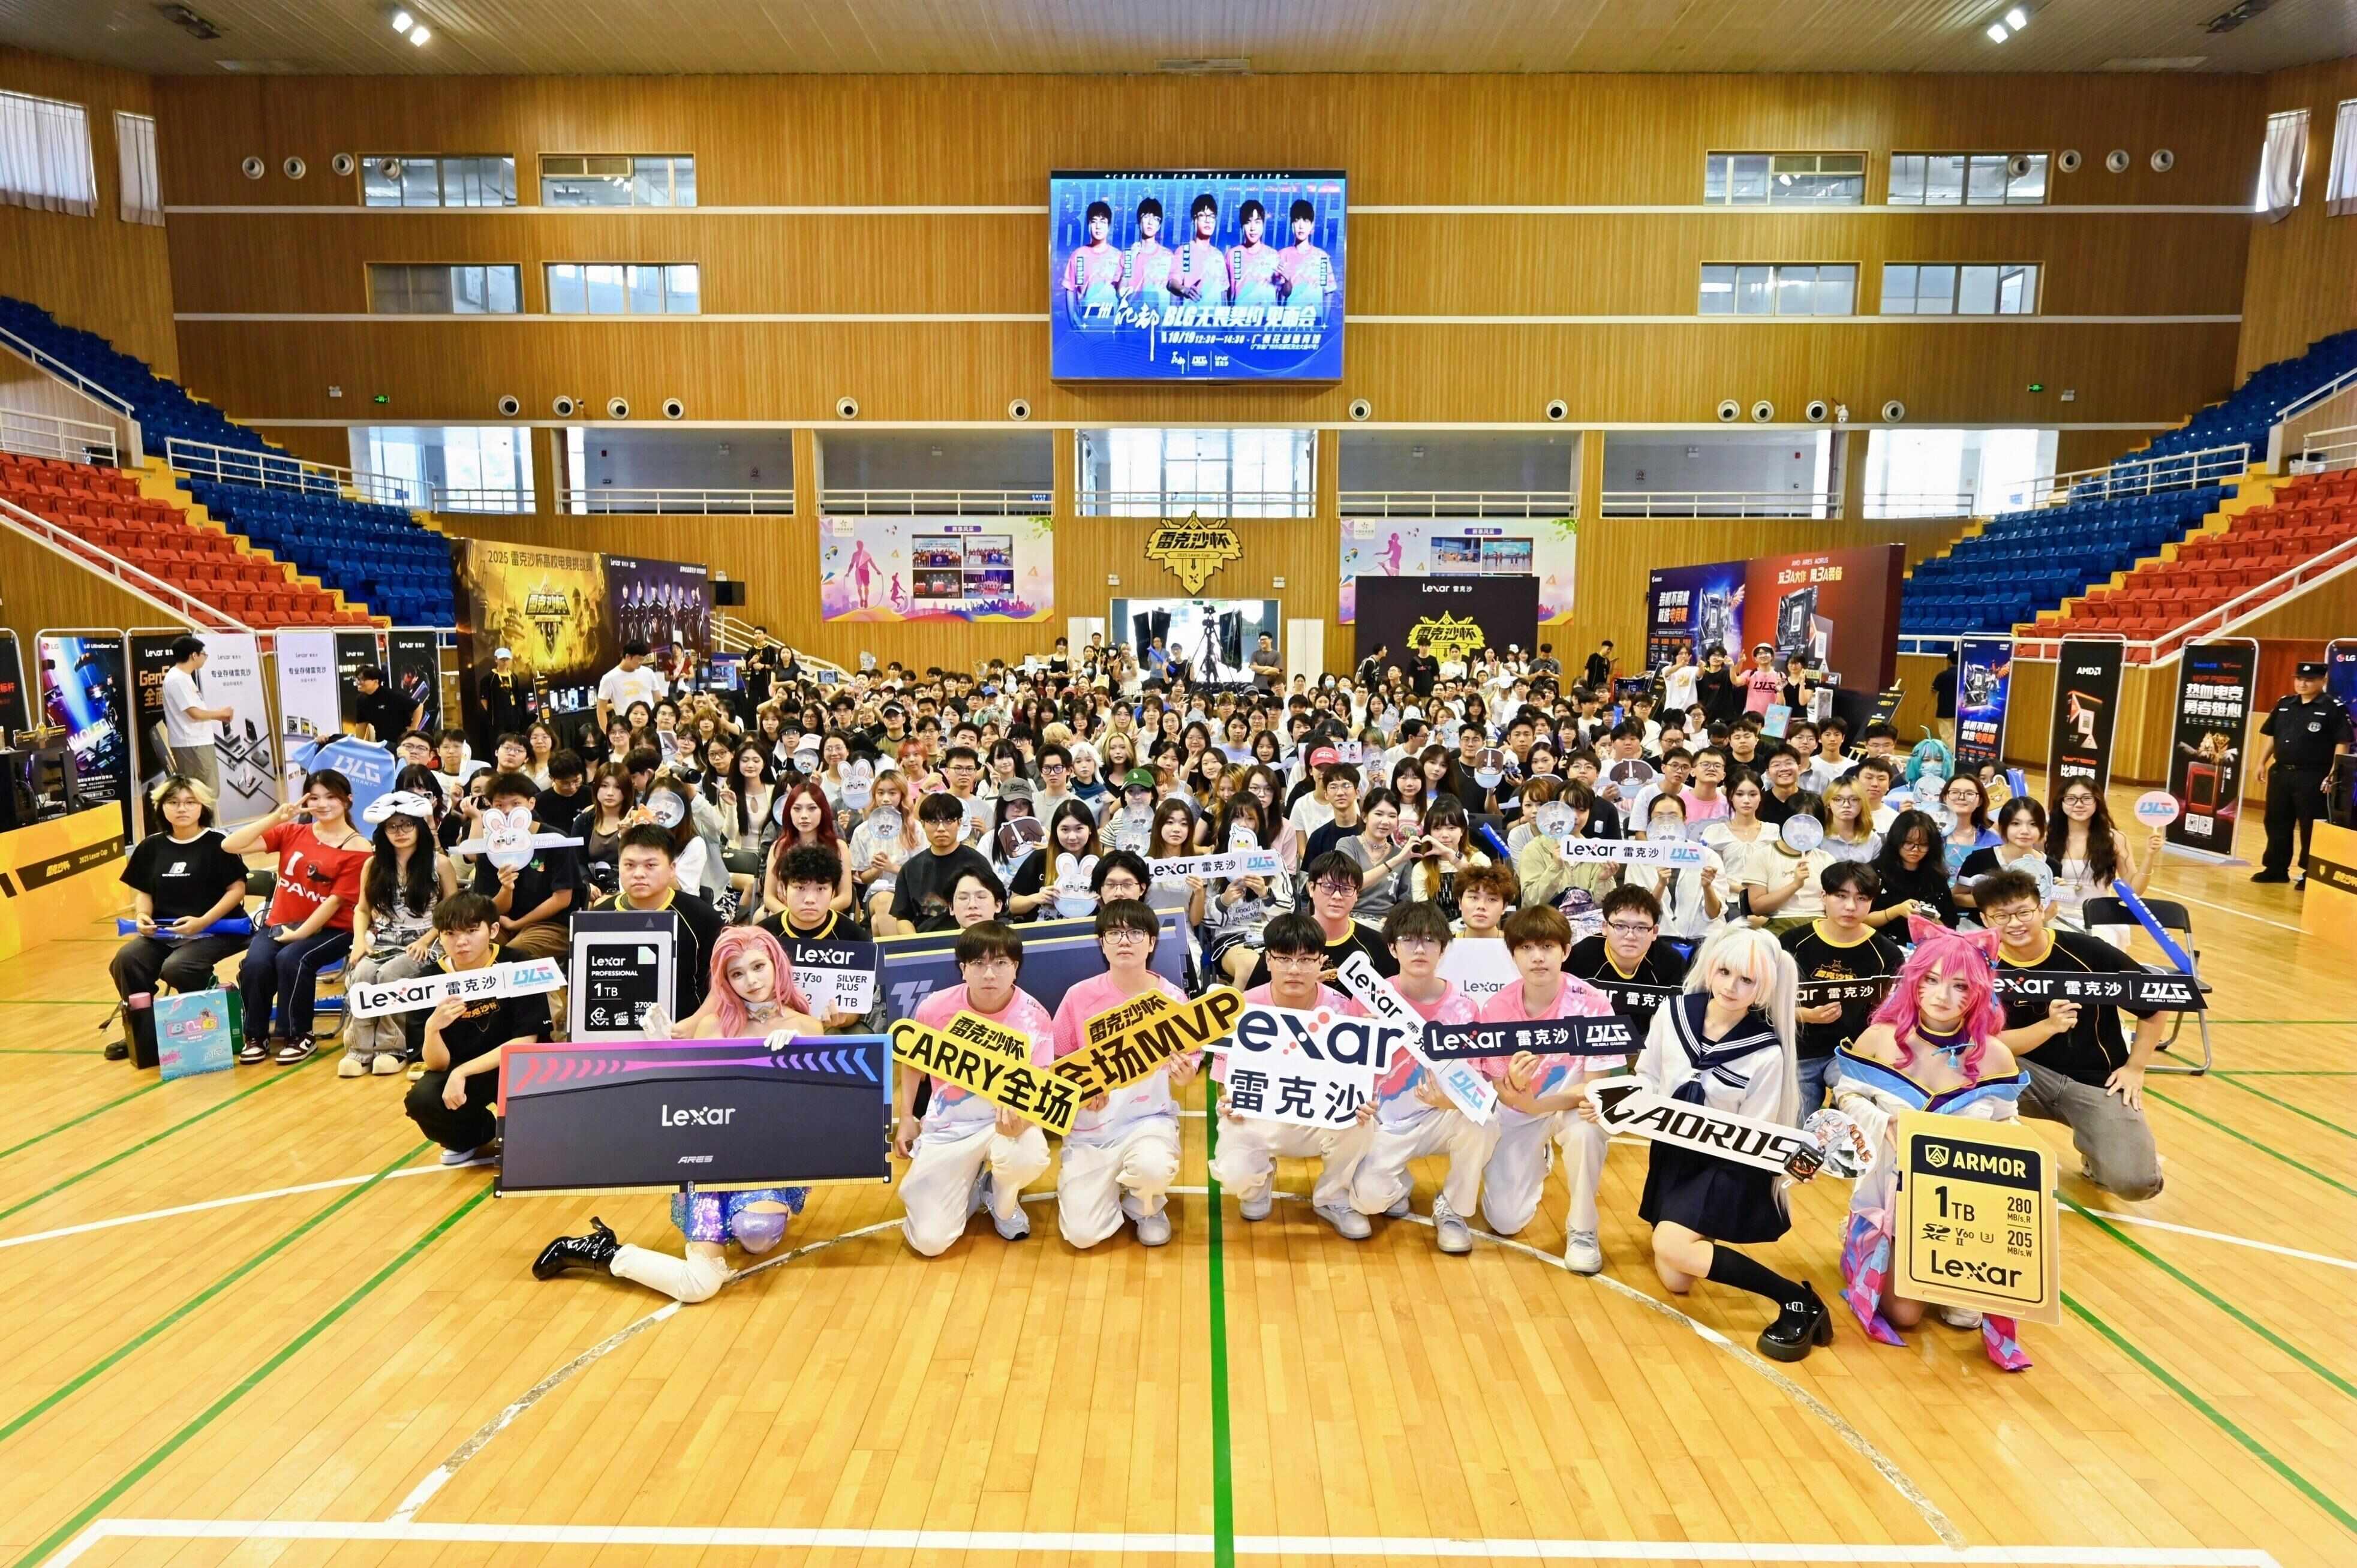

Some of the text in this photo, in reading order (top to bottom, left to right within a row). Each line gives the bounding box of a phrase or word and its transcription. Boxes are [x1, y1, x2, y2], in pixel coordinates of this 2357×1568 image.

[1084, 302, 1113, 320] 广州
[1156, 531, 1231, 549] 雷克沙杯
[488, 550, 593, 571] 2025 雷克沙杯高校电竞挑战赛
[1777, 566, 1843, 585] 玩3A大作 用3A装备
[1422, 583, 1450, 592] Lexar
[527, 594, 568, 615] 雷克沙杯
[1415, 626, 1477, 641] 雷克沙杯
[145, 649, 163, 658] Lexar
[211, 669, 251, 678] 专业存储雷克沙
[288, 666, 327, 675] 专业存储雷克沙
[2076, 666, 2095, 676] AMD
[2184, 683, 2244, 702] 热血电竞
[2183, 699, 2242, 718] 勇者雄心
[332, 754, 381, 784] BLG
[2139, 802, 2175, 814] BLG
[79, 848, 109, 864] 2025 Lexar Cup
[1566, 841, 1701, 860] Lexar 雷克沙 BLG
[284, 851, 304, 877] I
[1147, 856, 1276, 877] Lexar 雷克沙 BLG
[1235, 905, 1251, 914] Good
[591, 956, 626, 967] Lexar
[796, 943, 855, 965] Lexar
[803, 972, 867, 983] V30 SILVER
[1814, 969, 1854, 980] 雷克沙杯
[359, 984, 435, 1011] Lexar
[446, 975, 497, 996] 雷克沙
[513, 966, 555, 985] BLG
[1464, 980, 1506, 992] Lexar
[1827, 985, 1875, 999] 雷克沙
[1992, 976, 2193, 1000] exar 雷克沙 BLG
[1626, 990, 1671, 1007] 雷克沙
[1089, 994, 1168, 1045] 雷克沙杯
[948, 1016, 1025, 1061] 雷克沙杯
[1207, 1010, 1405, 1068] exar
[1345, 960, 1403, 1019] Lexar
[1448, 1069, 1487, 1110] BLG
[1431, 1024, 1632, 1051] Lexar 雷克沙 BLG
[1231, 1068, 1366, 1124] 雷克沙
[662, 1104, 736, 1127] Lexar
[1629, 1104, 1802, 1163] AORUS
[677, 1155, 714, 1164] ARES
[1953, 1150, 2027, 1179] ARMOR
[2007, 1196, 2033, 1215] 280
[1955, 1227, 1975, 1239] V60
[2007, 1230, 2033, 1249] 205
[1931, 1249, 2023, 1288] Lexar
